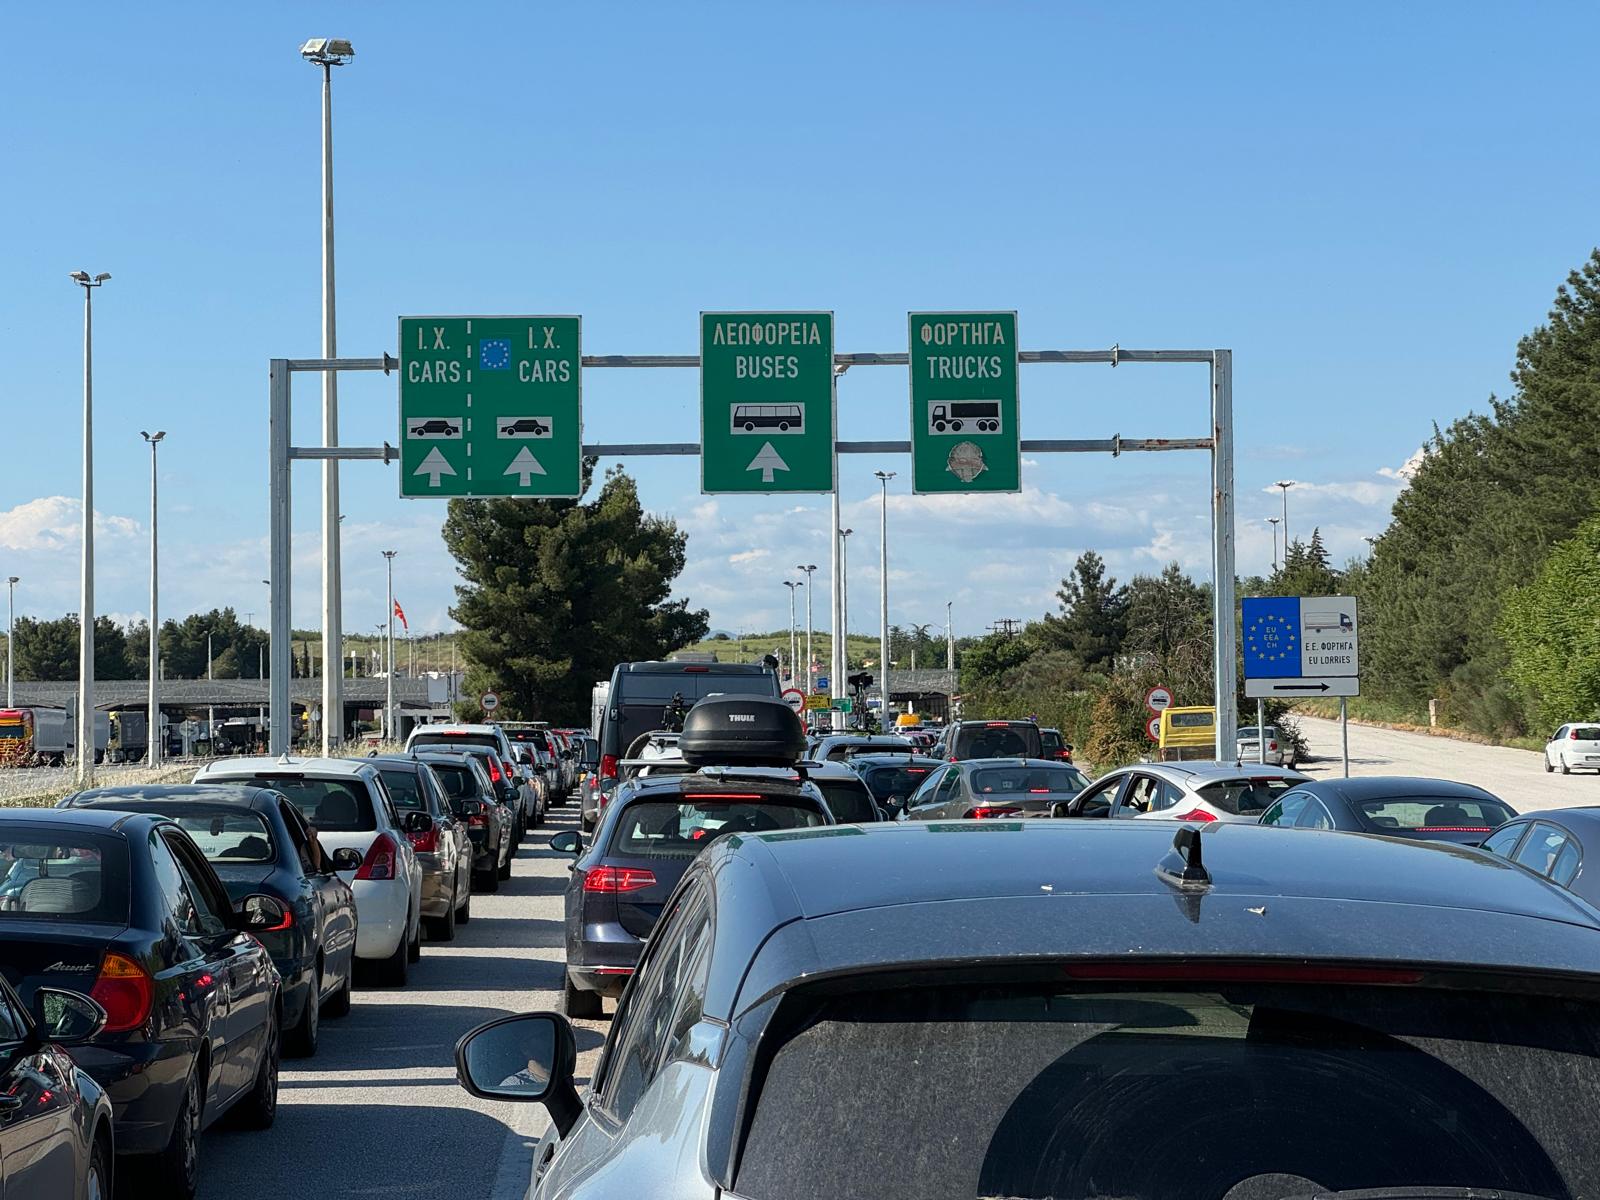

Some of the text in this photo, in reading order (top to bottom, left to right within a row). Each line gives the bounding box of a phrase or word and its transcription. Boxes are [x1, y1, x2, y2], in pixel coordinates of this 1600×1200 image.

[713, 322, 821, 345] ΛΕΩΦΟΡΕΙΑ
[920, 322, 1005, 346] ΦΟΡΤΗΓΑ
[408, 360, 461, 383] CARS
[519, 359, 570, 383] CARS
[736, 355, 799, 379] BUSES
[926, 355, 1002, 379] TRUCKS
[1265, 626, 1277, 634] EU
[1320, 641, 1353, 651] ΦΟΡΤΗΓΑ
[1308, 655, 1351, 665] EU LORRIES
[728, 714, 755, 722] THULE
[42, 960, 95, 972] Accent
